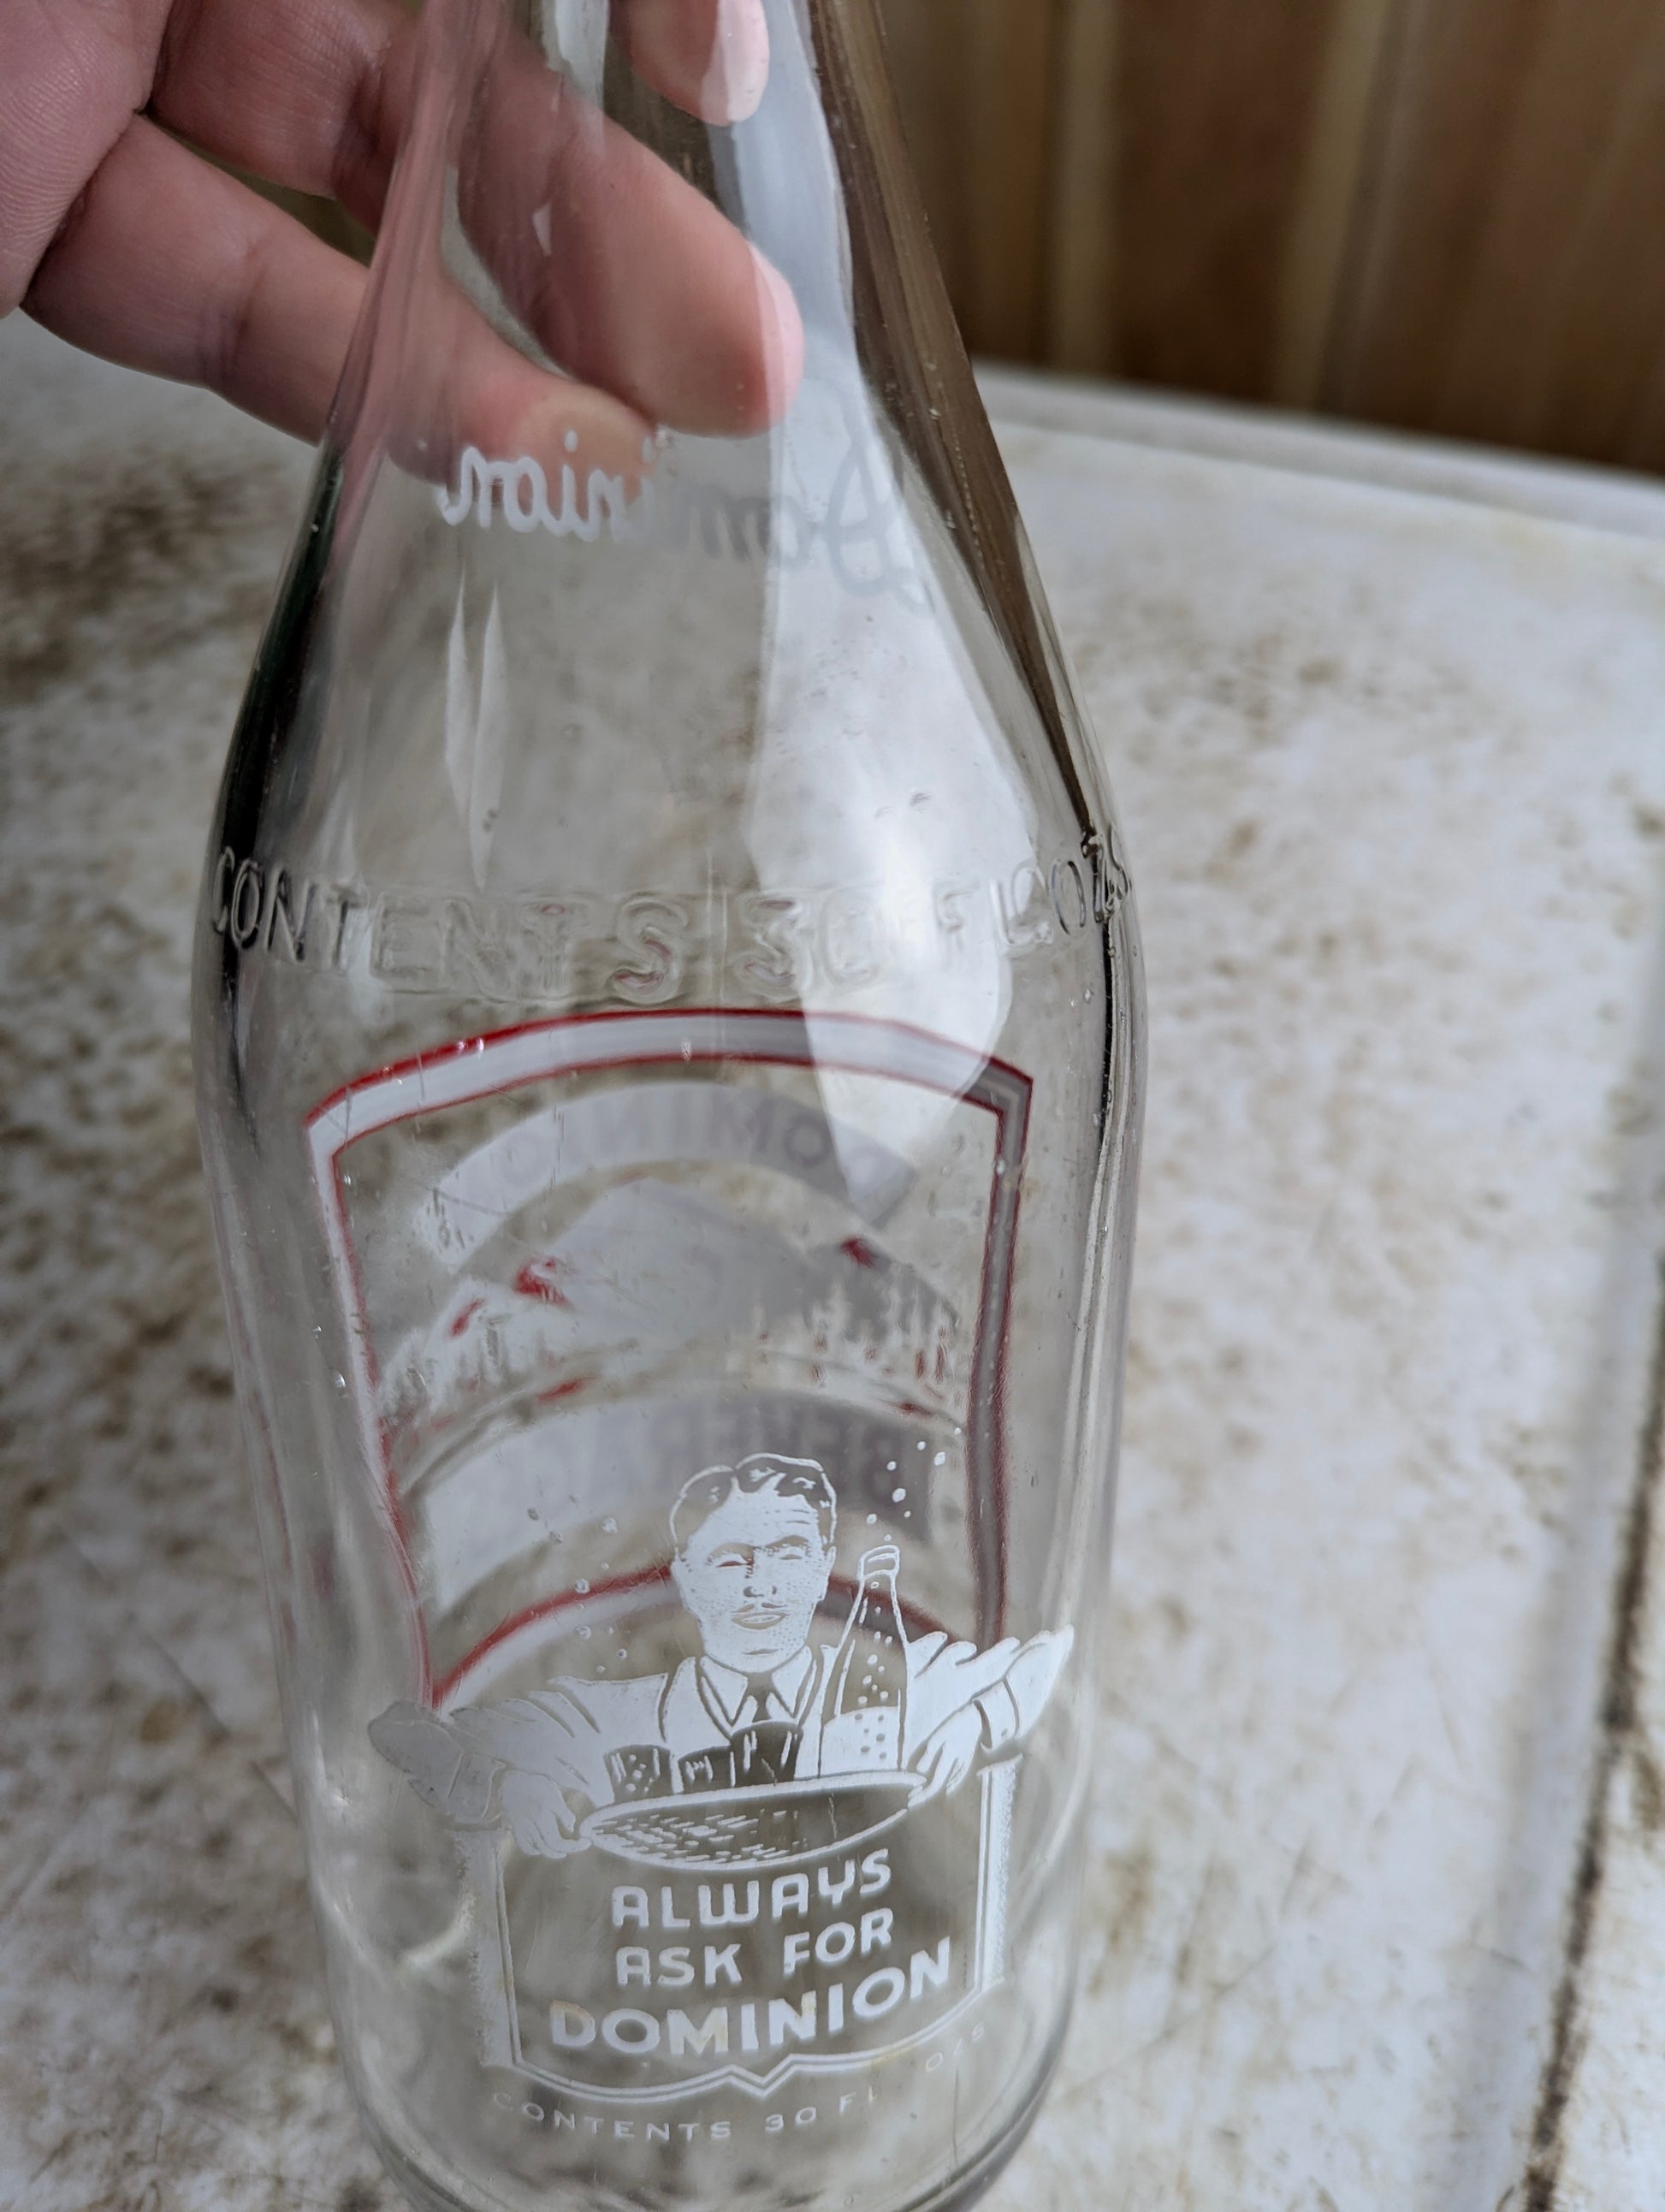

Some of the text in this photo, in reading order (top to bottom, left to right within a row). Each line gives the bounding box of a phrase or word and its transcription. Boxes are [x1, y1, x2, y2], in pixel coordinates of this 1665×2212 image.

[214, 845, 690, 1006] CONTENTS
[612, 1847, 892, 1929] ALWAYS
[615, 1907, 894, 1987] ASK FOR
[548, 1936, 951, 2055] DOMINION
[493, 2092, 732, 2141] CONTENTS
[766, 2107, 816, 2132] 30
